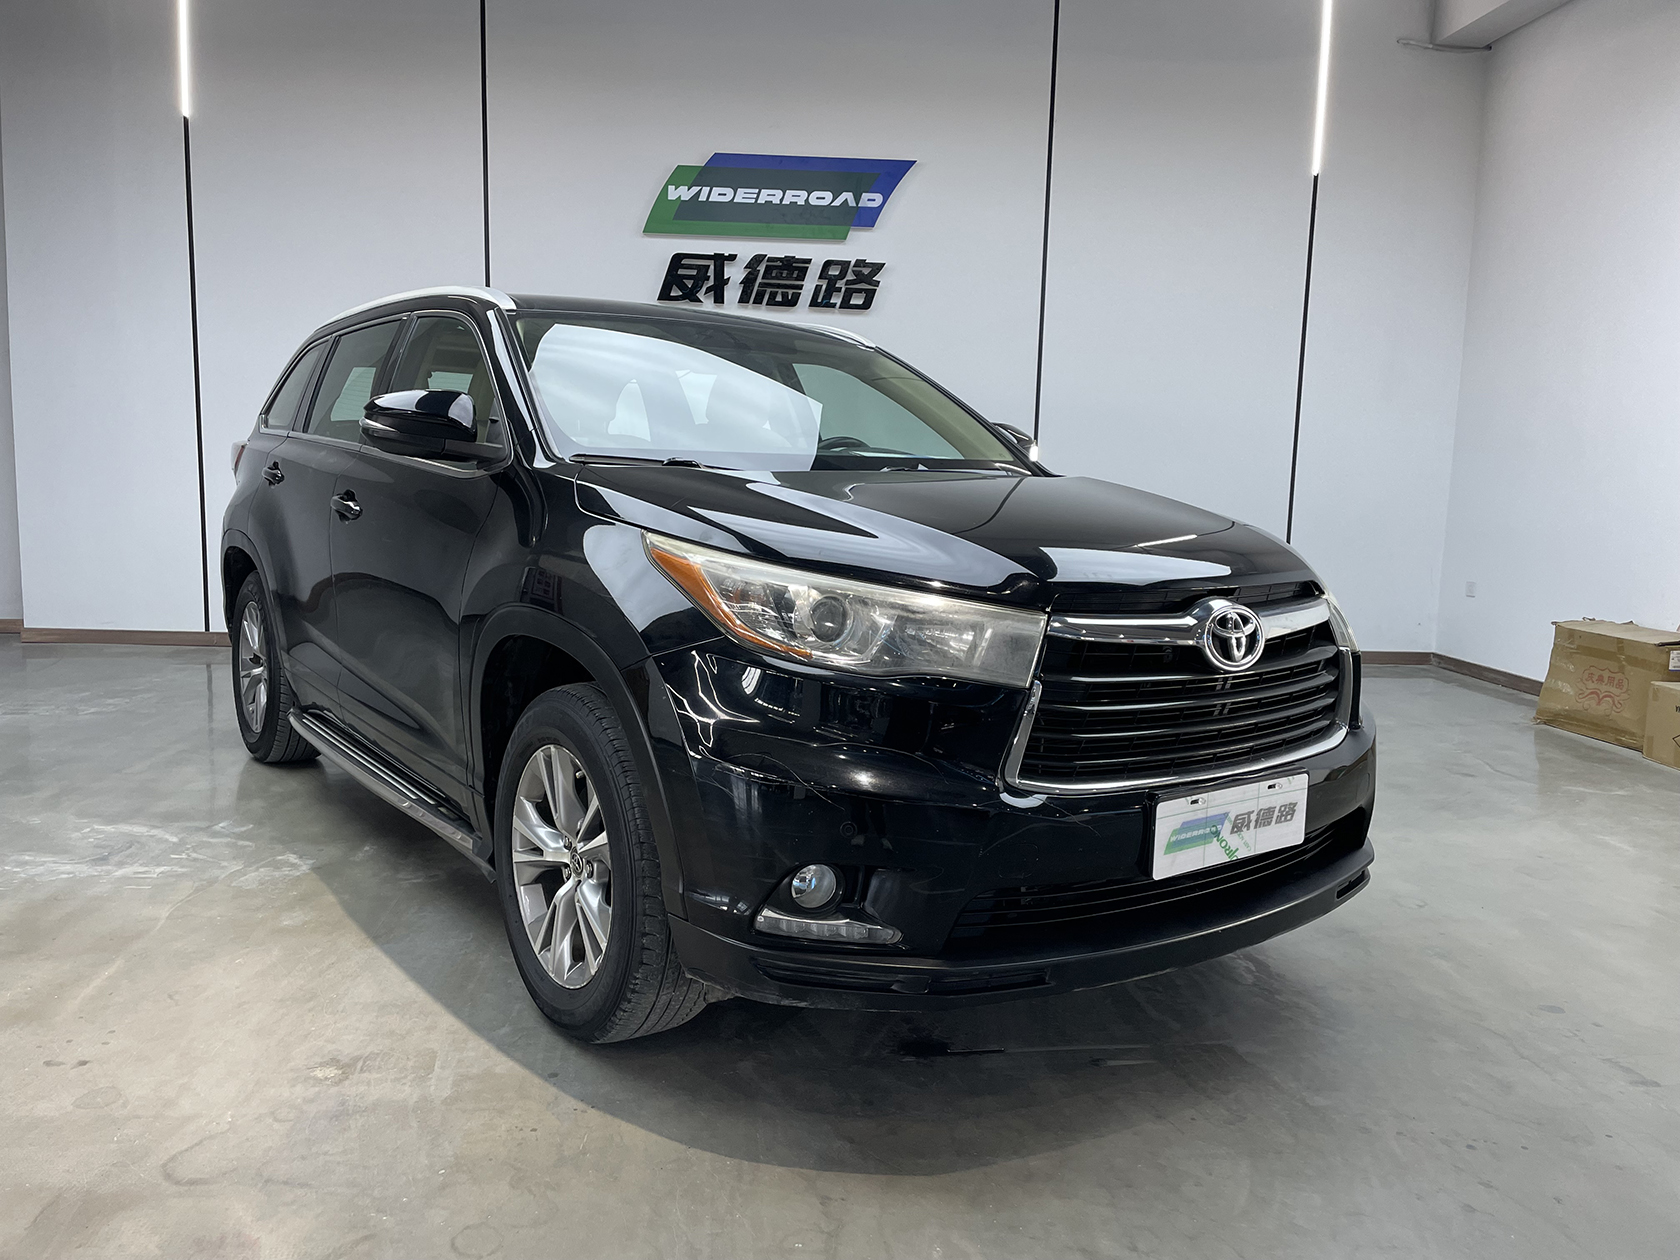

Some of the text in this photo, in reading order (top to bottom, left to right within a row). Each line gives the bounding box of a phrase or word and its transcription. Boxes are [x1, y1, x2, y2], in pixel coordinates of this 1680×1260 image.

[667, 185, 884, 208] WIDERROAD
[657, 252, 886, 311] 威德路
[1230, 801, 1298, 835] 威德路
